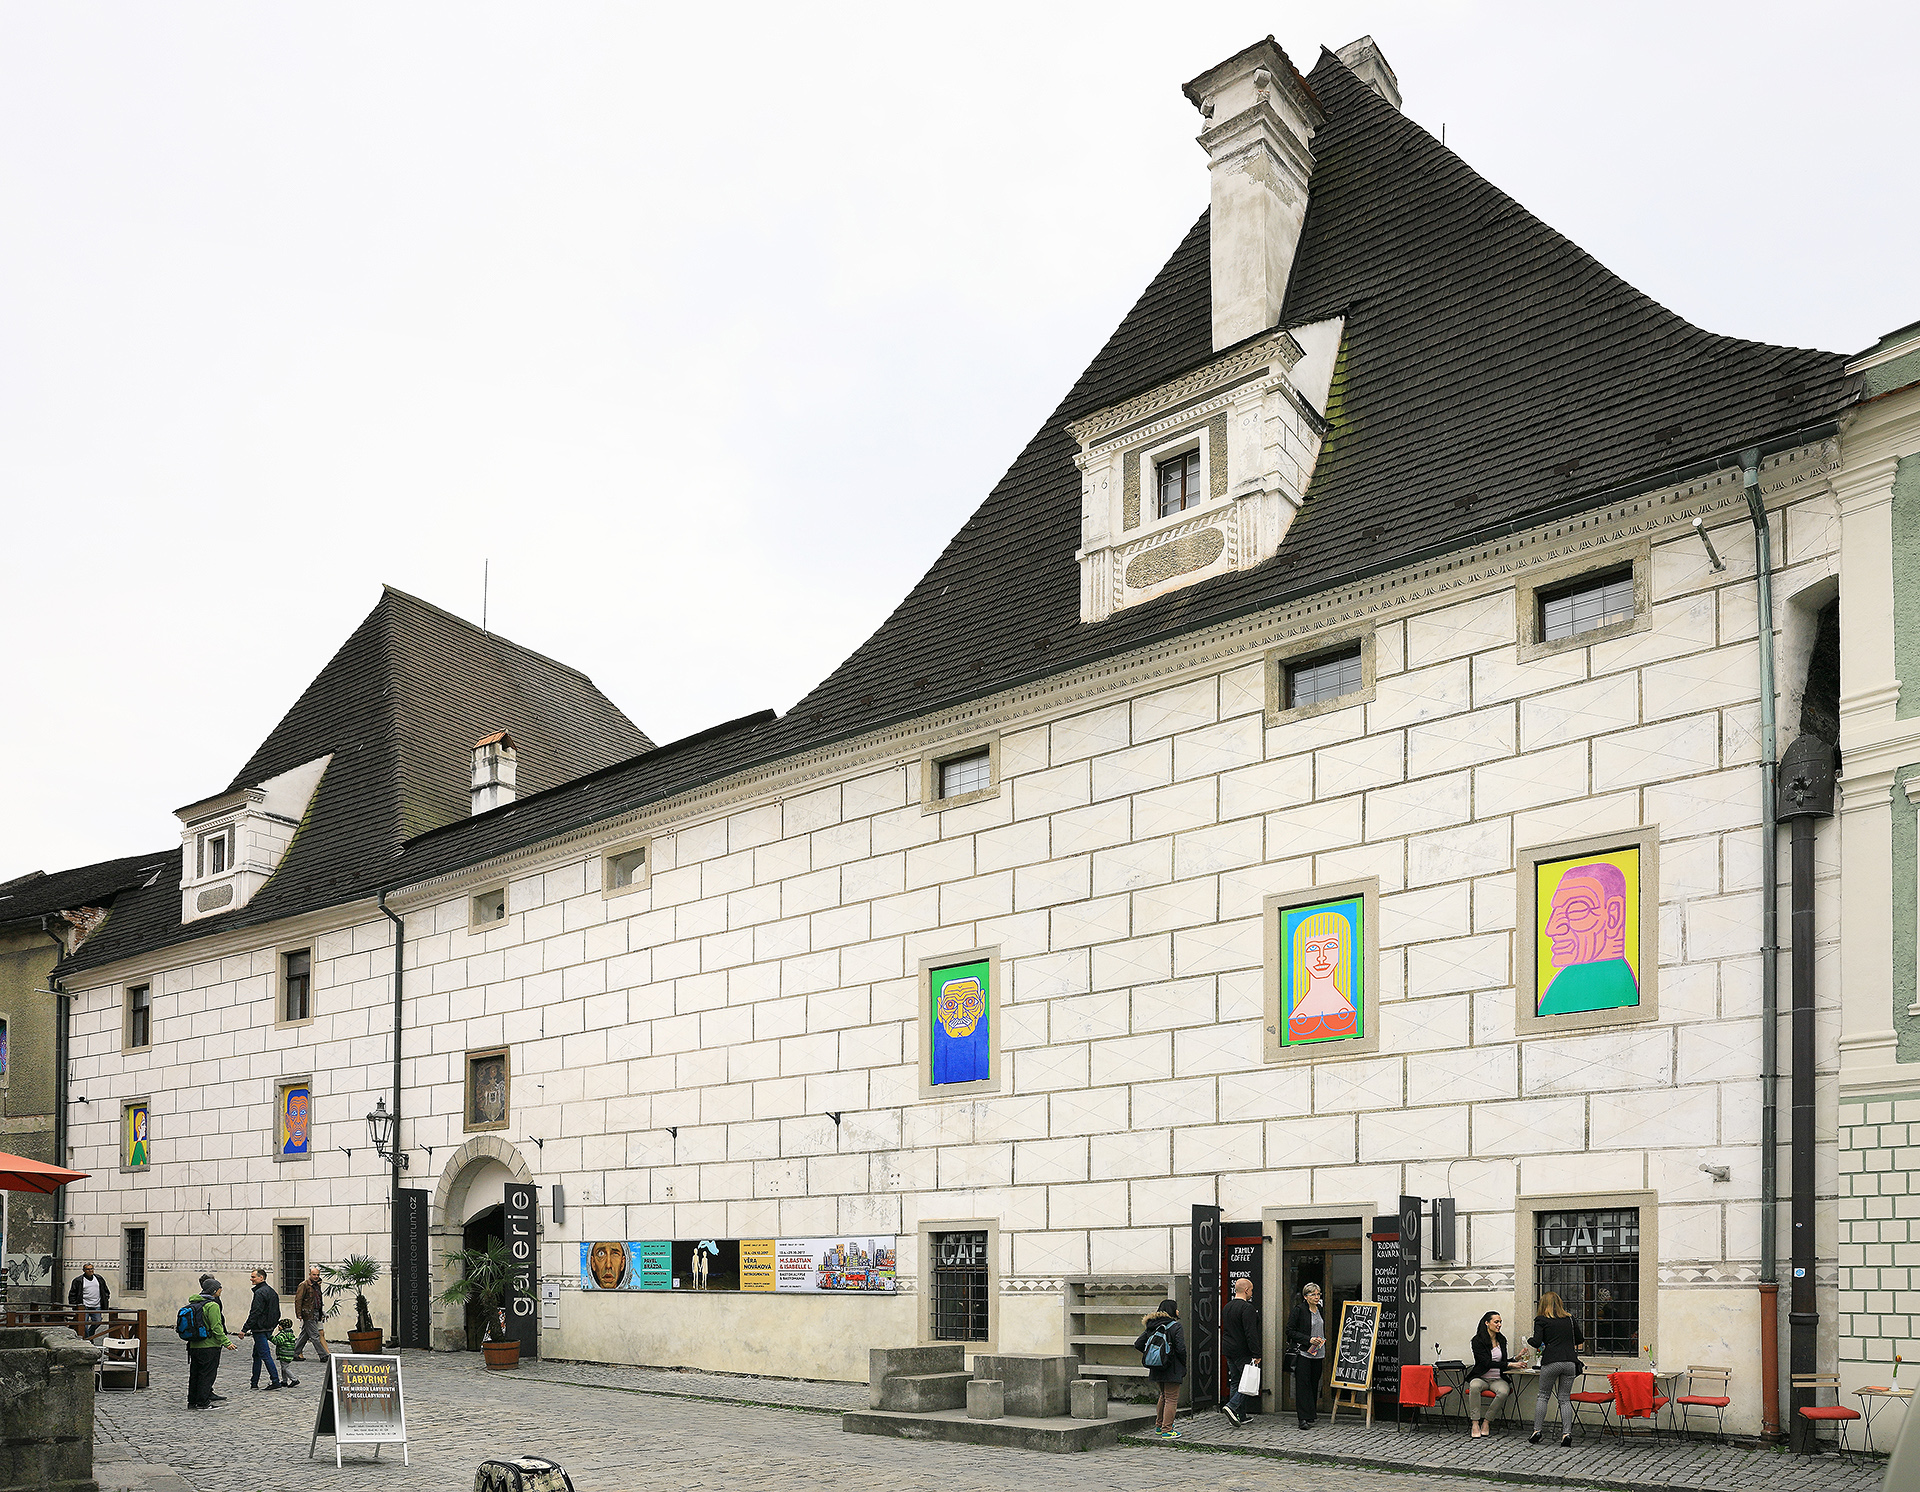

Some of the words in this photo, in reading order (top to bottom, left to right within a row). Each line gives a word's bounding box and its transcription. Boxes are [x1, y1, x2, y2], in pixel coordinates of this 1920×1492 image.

[941, 1234, 988, 1266] CAF
[1377, 1242, 1400, 1250] RODINN
[1231, 1254, 1251, 1262] COFFEE
[409, 1195, 419, 1342] www.schieleartcentrum.cz
[1402, 1209, 1418, 1342] café
[1194, 1217, 1213, 1401] kavárna
[1352, 1305, 1361, 1315] OH
[342, 1364, 390, 1374] ZRCADLOVÝ
[347, 1375, 388, 1384] LABYRINT
